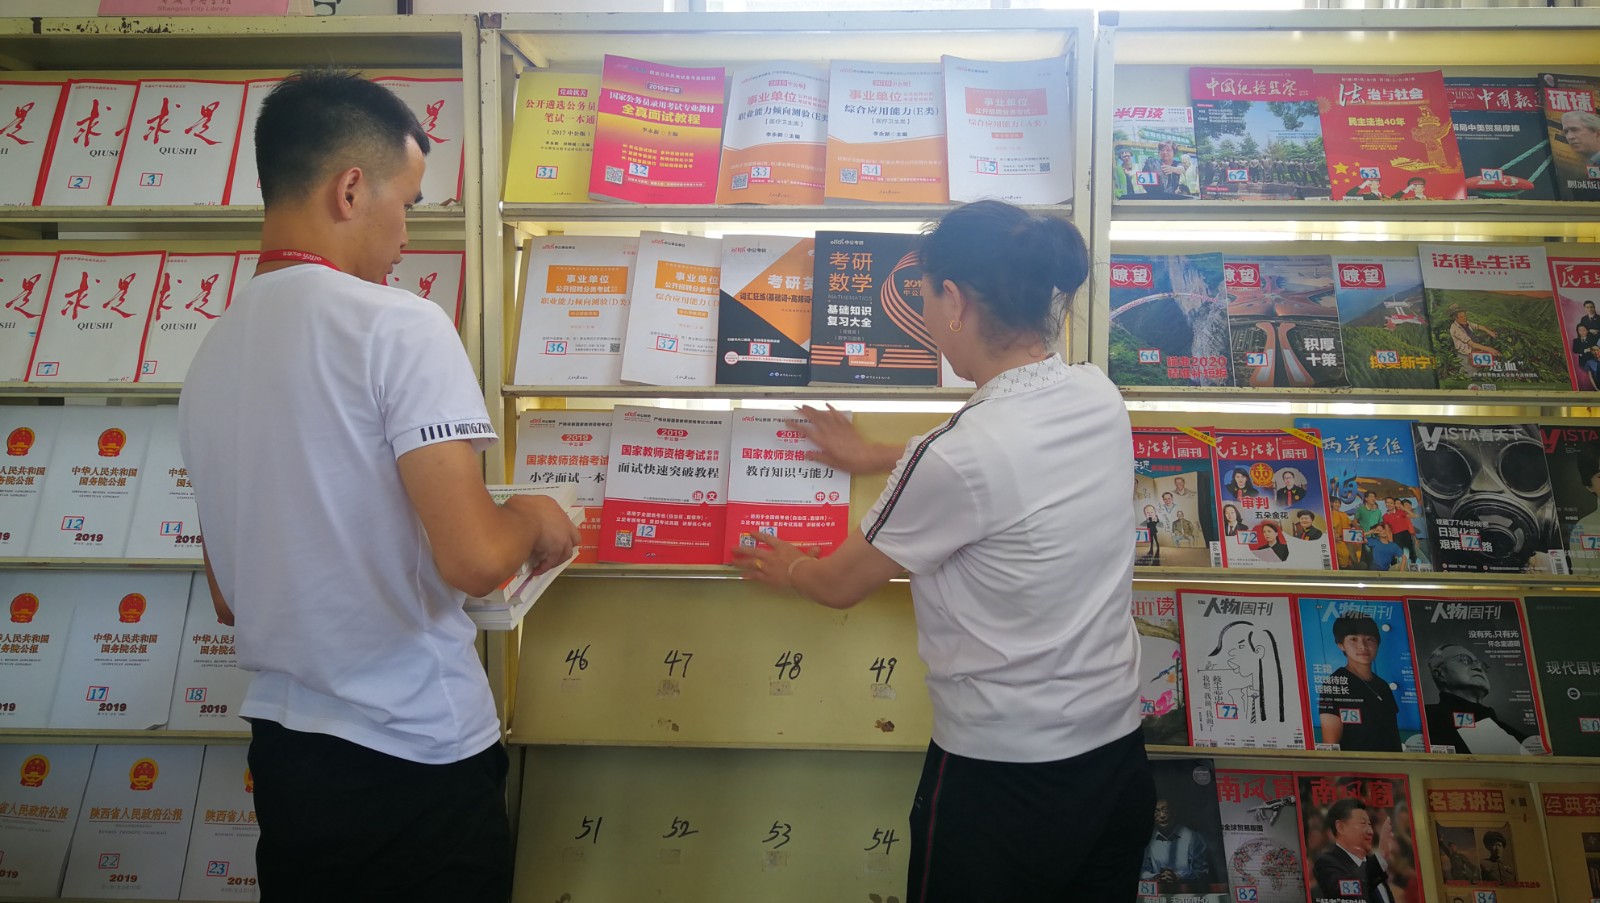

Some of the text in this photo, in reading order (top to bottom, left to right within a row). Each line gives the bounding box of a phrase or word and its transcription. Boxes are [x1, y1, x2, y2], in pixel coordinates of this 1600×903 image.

[205, 5, 231, 13] Library
[746, 90, 797, 105] 事业单位
[849, 89, 902, 102] 事业单位
[1338, 82, 1425, 108] 法治与社会
[1547, 89, 1594, 113] 环球
[525, 99, 597, 112] 公开遴选公务员
[544, 112, 596, 125] 笔试一本通
[621, 104, 701, 125] 全真面试教程
[1113, 106, 1166, 120] 半月谈
[72, 98, 128, 148] 求
[142, 96, 223, 146] 求是
[1348, 116, 1406, 128] 民主法治40年
[158, 146, 198, 156] QIUSHI
[538, 166, 554, 178] 31
[630, 163, 648, 176] 32
[1228, 169, 1248, 181] 62
[1360, 168, 1379, 179] 63
[1483, 169, 1501, 181] 64
[73, 177, 84, 189] 2
[147, 174, 156, 186] 3
[1137, 172, 1156, 184] 61
[829, 251, 873, 272] 考研
[1431, 252, 1531, 271] 法律与生活
[566, 274, 610, 284] 事业单位
[675, 271, 720, 285] 事业单位
[828, 272, 873, 293] 数学
[1110, 268, 1151, 284] 瞭望
[1342, 268, 1382, 284] 瞭望
[555, 285, 611, 293] 公开招聘分类考试
[60, 271, 137, 321] 求是
[827, 294, 873, 302] MATHEMATICS
[827, 304, 873, 317] 基础知识
[77, 321, 114, 331] QIUSHI
[160, 322, 198, 331] QIUSHI
[826, 315, 873, 328] 复习大全
[546, 342, 565, 353] 36
[658, 338, 677, 350] 37
[1303, 337, 1335, 352] 积厚
[1140, 350, 1159, 362] 66
[1166, 355, 1228, 368] 瞄准2020
[1246, 353, 1265, 366] 67
[1305, 352, 1338, 367] 十策
[1378, 351, 1397, 363] 68
[1473, 353, 1492, 365] 69
[43, 363, 53, 375] 7
[565, 434, 590, 442] 2019
[661, 428, 685, 437] 2019
[1417, 425, 1524, 451] VISTA看天下
[620, 444, 707, 461] 国家教师资格考试
[1177, 447, 1203, 458] 周刊
[1281, 447, 1308, 460] 周刊
[526, 454, 609, 466] 国家教师资格考试
[71, 465, 138, 478] 中华人民共和国
[617, 461, 720, 479] 面试快速突破教程
[745, 465, 835, 480] 教育知识与能力
[78, 477, 127, 488] 国务院公报
[529, 471, 606, 484] 小学面试一本
[691, 490, 718, 502] 语文
[815, 491, 840, 501] 中学
[1240, 496, 1270, 510] 审判
[1254, 510, 1290, 521] 五朵金花
[65, 518, 84, 529] 12
[163, 523, 182, 534] 14
[74, 532, 104, 543] 2019
[174, 534, 203, 544] 2019
[1240, 532, 1258, 544] 72
[1464, 535, 1481, 549] 74
[1156, 596, 1176, 617] 读
[1202, 596, 1274, 618] 人物周刊
[1321, 600, 1394, 623] 人物周刊
[1430, 602, 1503, 624] 人物周刊
[92, 633, 159, 645] 中华人民共和国
[100, 643, 148, 655] 国务院公报
[564, 644, 898, 685] 46 47 48 49
[1313, 674, 1350, 687] 玫瑰待放
[88, 687, 107, 701] 17
[188, 688, 205, 701] 18
[1314, 684, 1351, 696] 铿锵生长
[98, 702, 127, 713] 2019
[199, 704, 228, 715] 2019
[1221, 704, 1239, 719] 77
[1340, 709, 1360, 723] 78
[1455, 713, 1474, 727] 79
[1215, 775, 1295, 804] 南风窗
[1429, 790, 1505, 812] 名家讲坛
[1543, 795, 1600, 815] 经典杂
[88, 806, 184, 821] 陕西省人民政府公报
[574, 815, 900, 855] 51 52 53 54
[100, 854, 119, 868] 22
[208, 862, 226, 876] 23
[108, 873, 138, 884] 2019
[226, 876, 257, 887] 2019
[1140, 881, 1156, 895] 81
[1341, 880, 1362, 894] 83
[1238, 887, 1257, 901] 82
